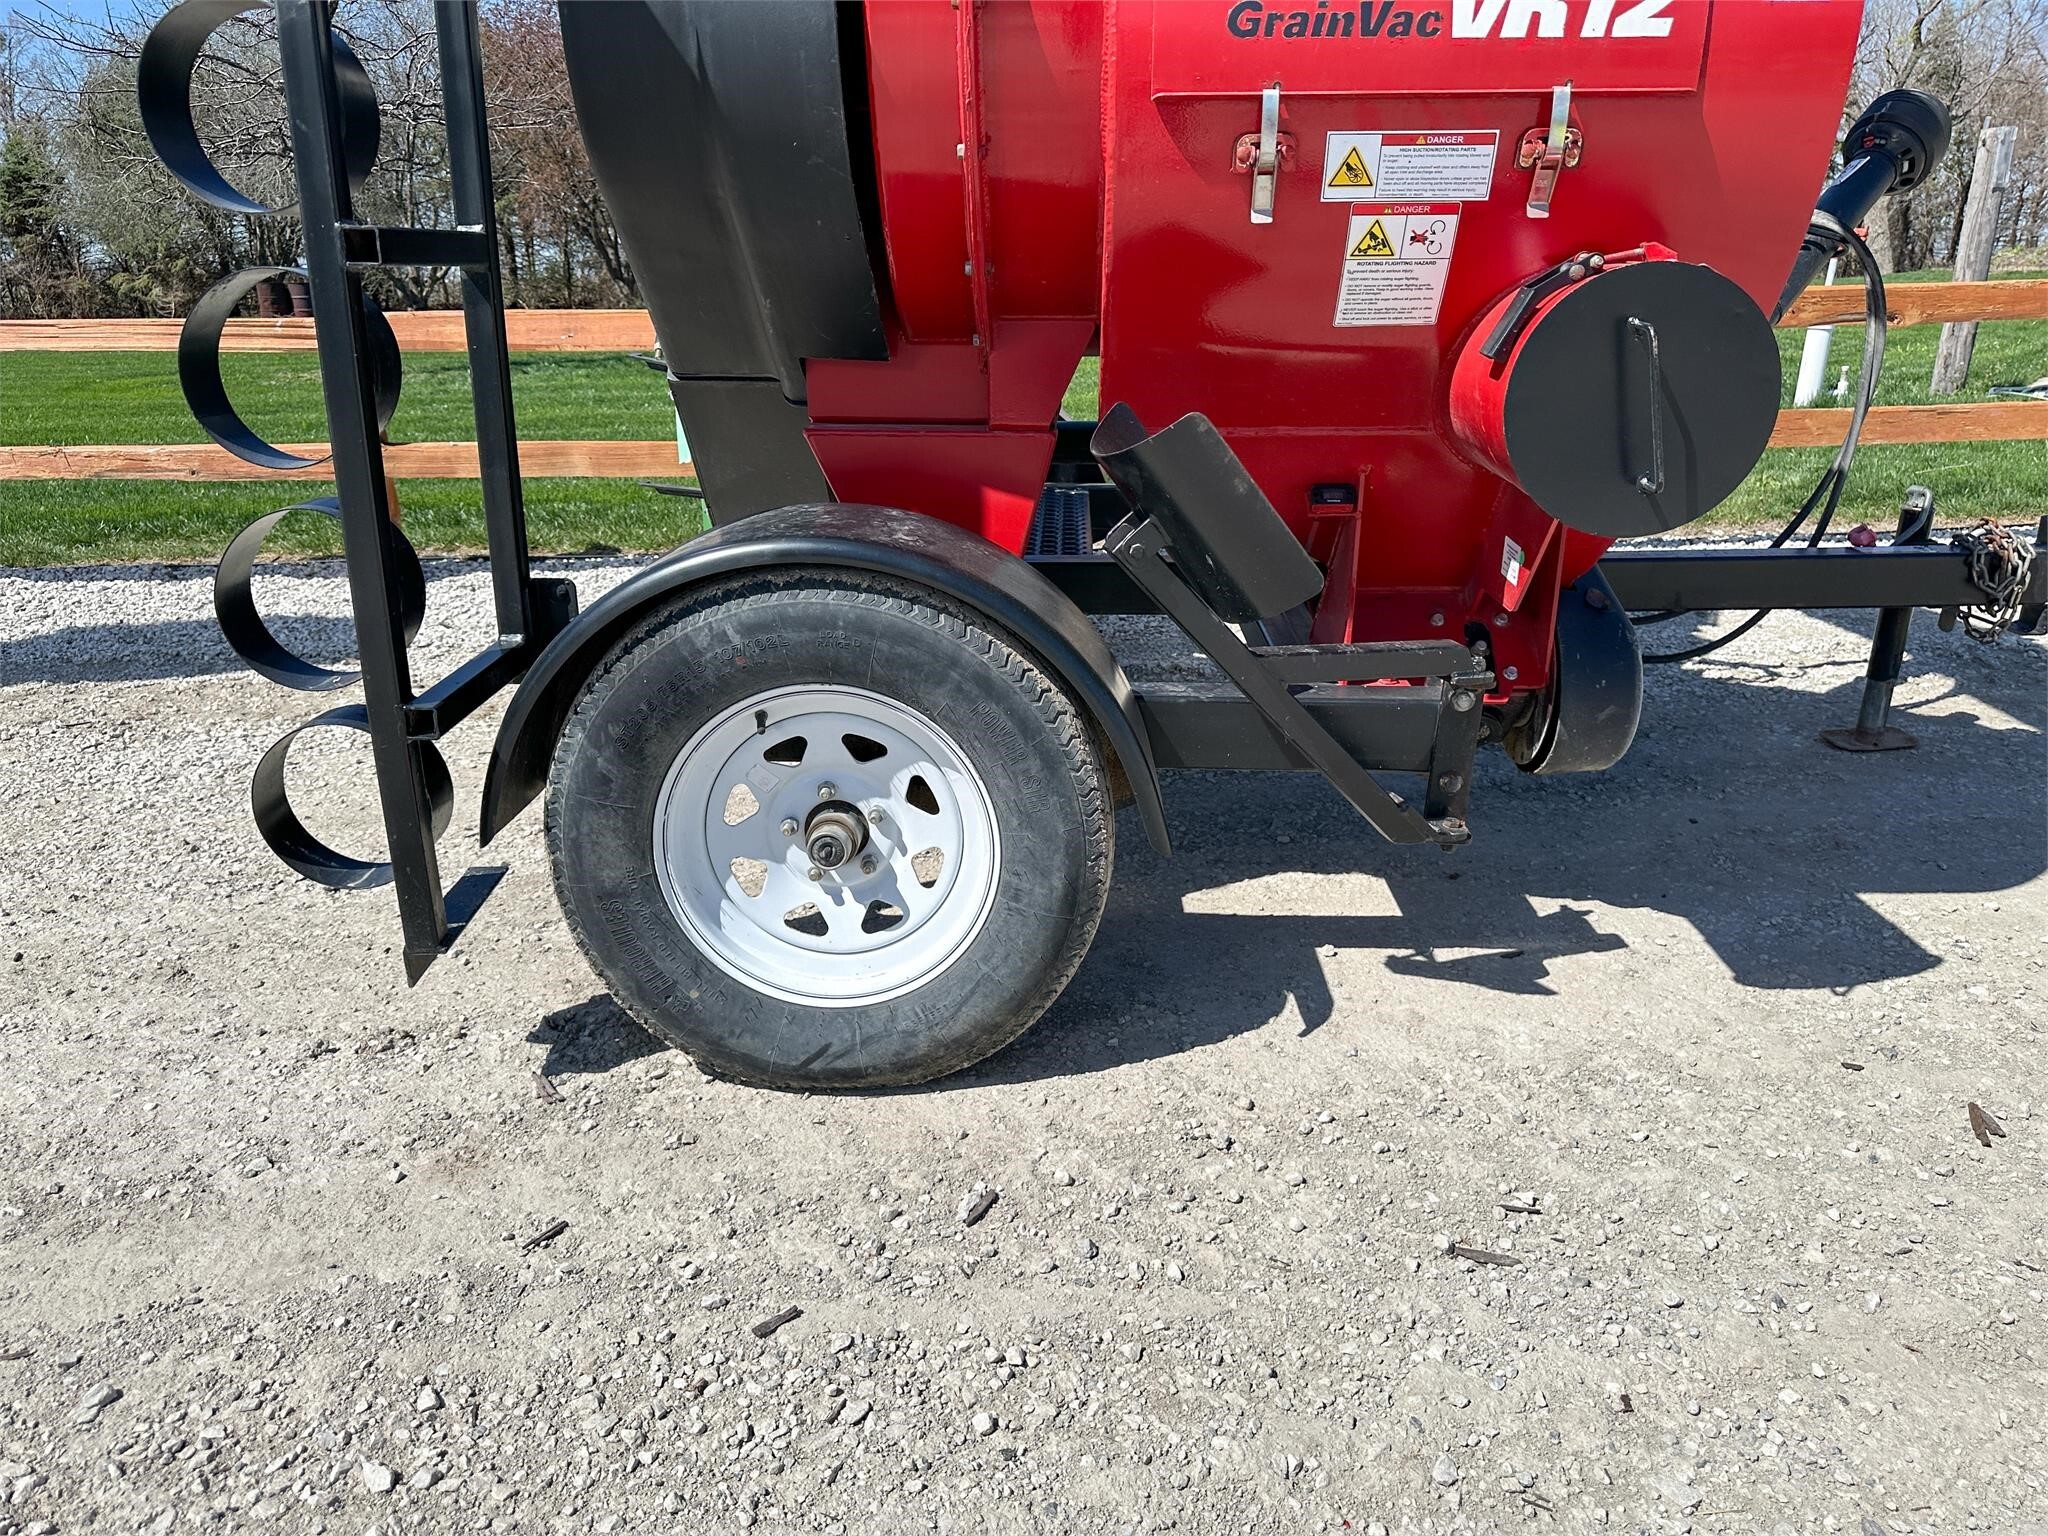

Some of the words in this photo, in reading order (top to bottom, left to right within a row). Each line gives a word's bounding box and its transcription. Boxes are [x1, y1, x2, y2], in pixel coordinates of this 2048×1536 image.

[1227, 0, 1441, 38] GrainVac
[1427, 135, 1464, 144] DANGER
[615, 658, 707, 750] ST20575R15
[625, 864, 639, 893] TIRE
[600, 899, 675, 996] HERCULES
